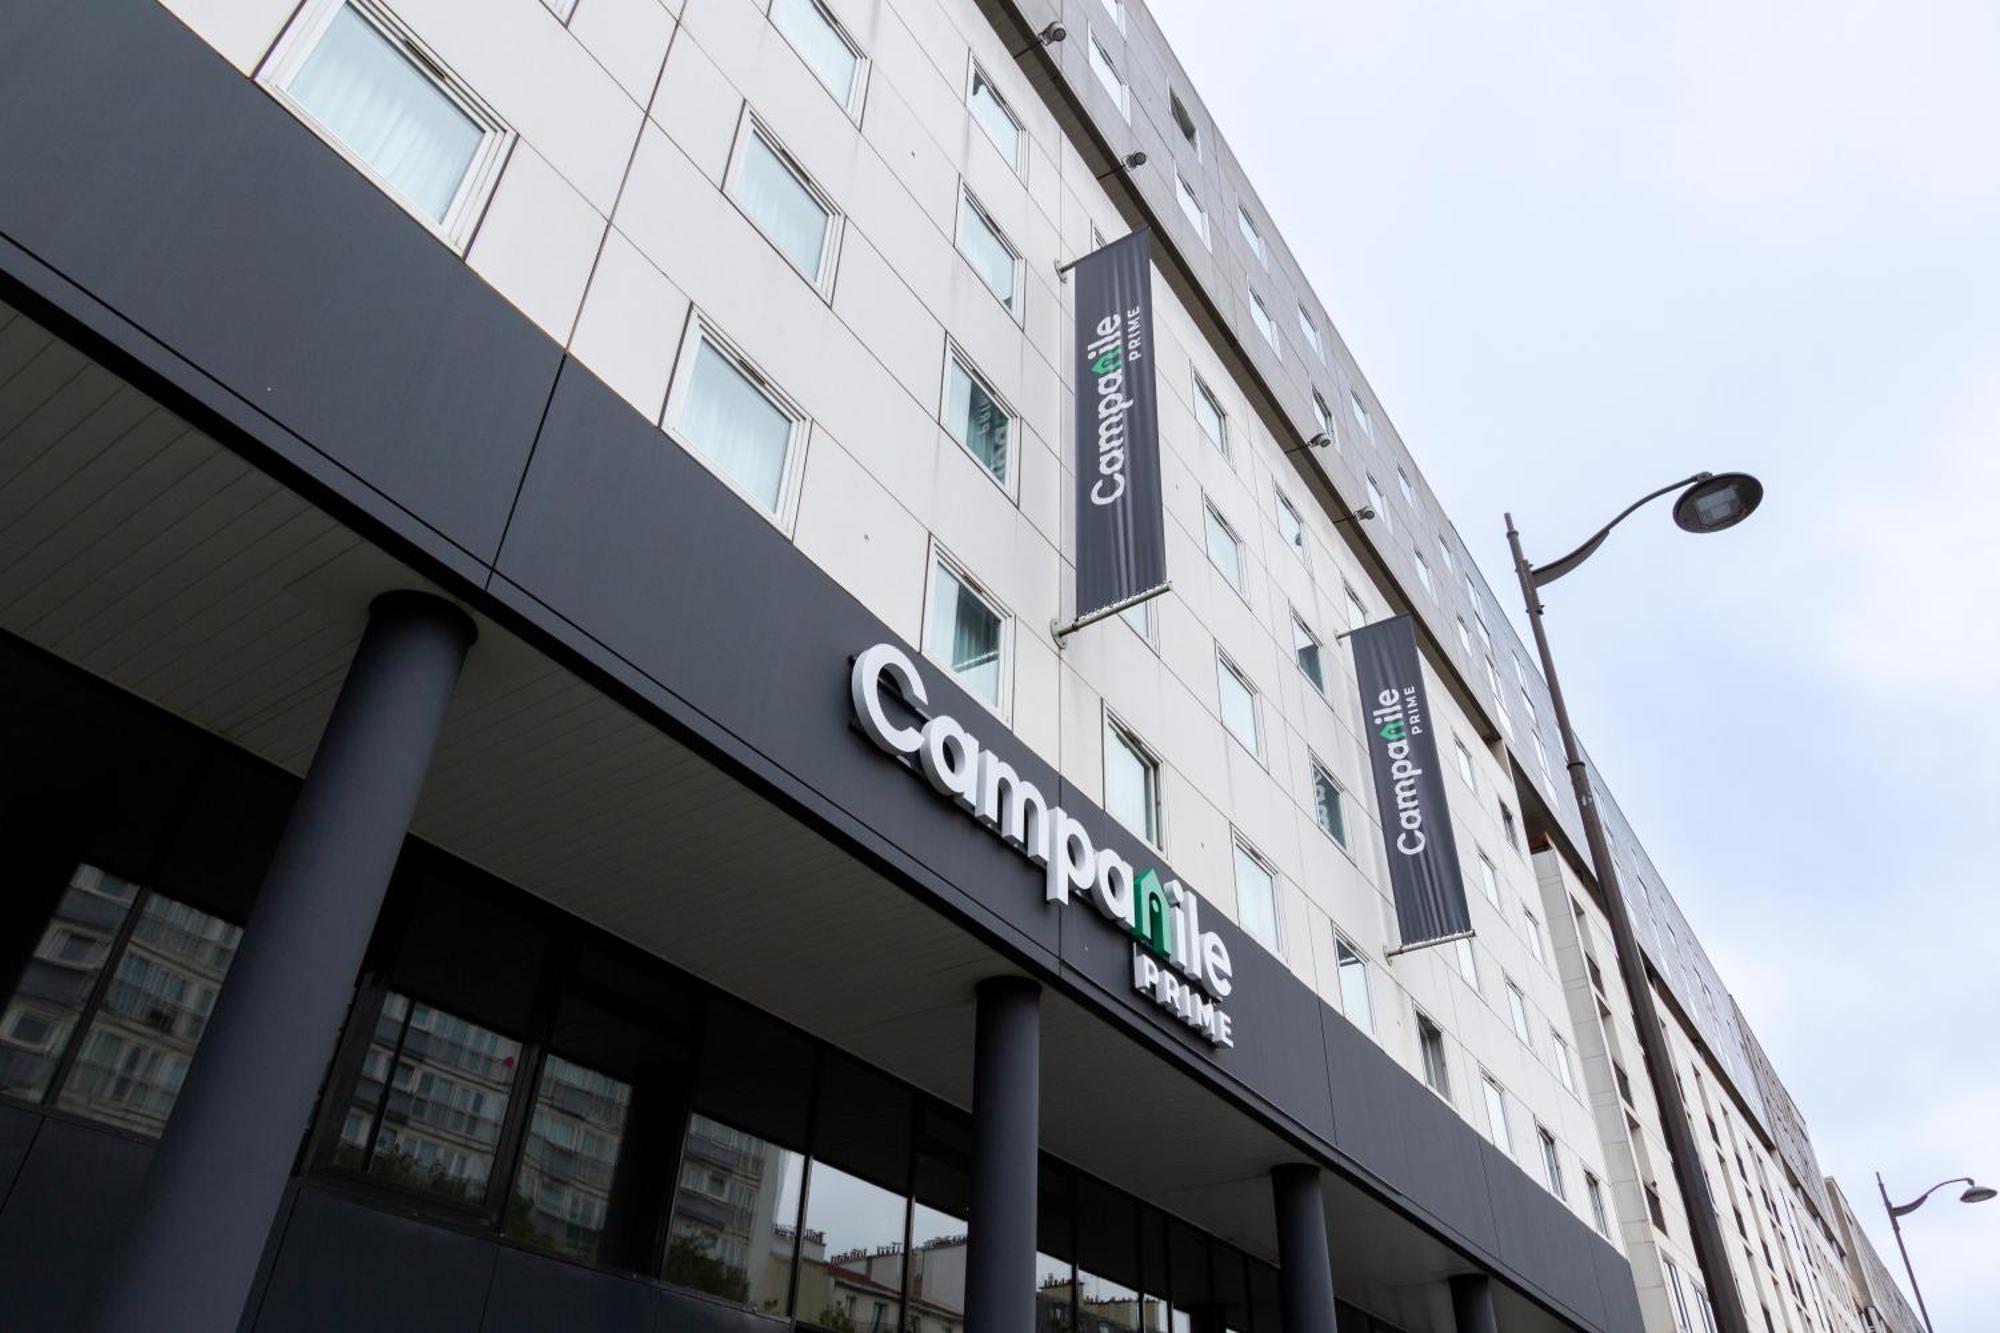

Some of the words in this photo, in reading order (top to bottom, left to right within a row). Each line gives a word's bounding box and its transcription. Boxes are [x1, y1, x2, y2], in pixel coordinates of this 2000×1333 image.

[1127, 305, 1141, 362] PRIME
[1087, 313, 1134, 506] Campanile
[1372, 688, 1426, 856] Campanile
[1403, 685, 1424, 736] PRIME
[852, 643, 1233, 998] Campanile
[1133, 945, 1234, 1049] PRIME
